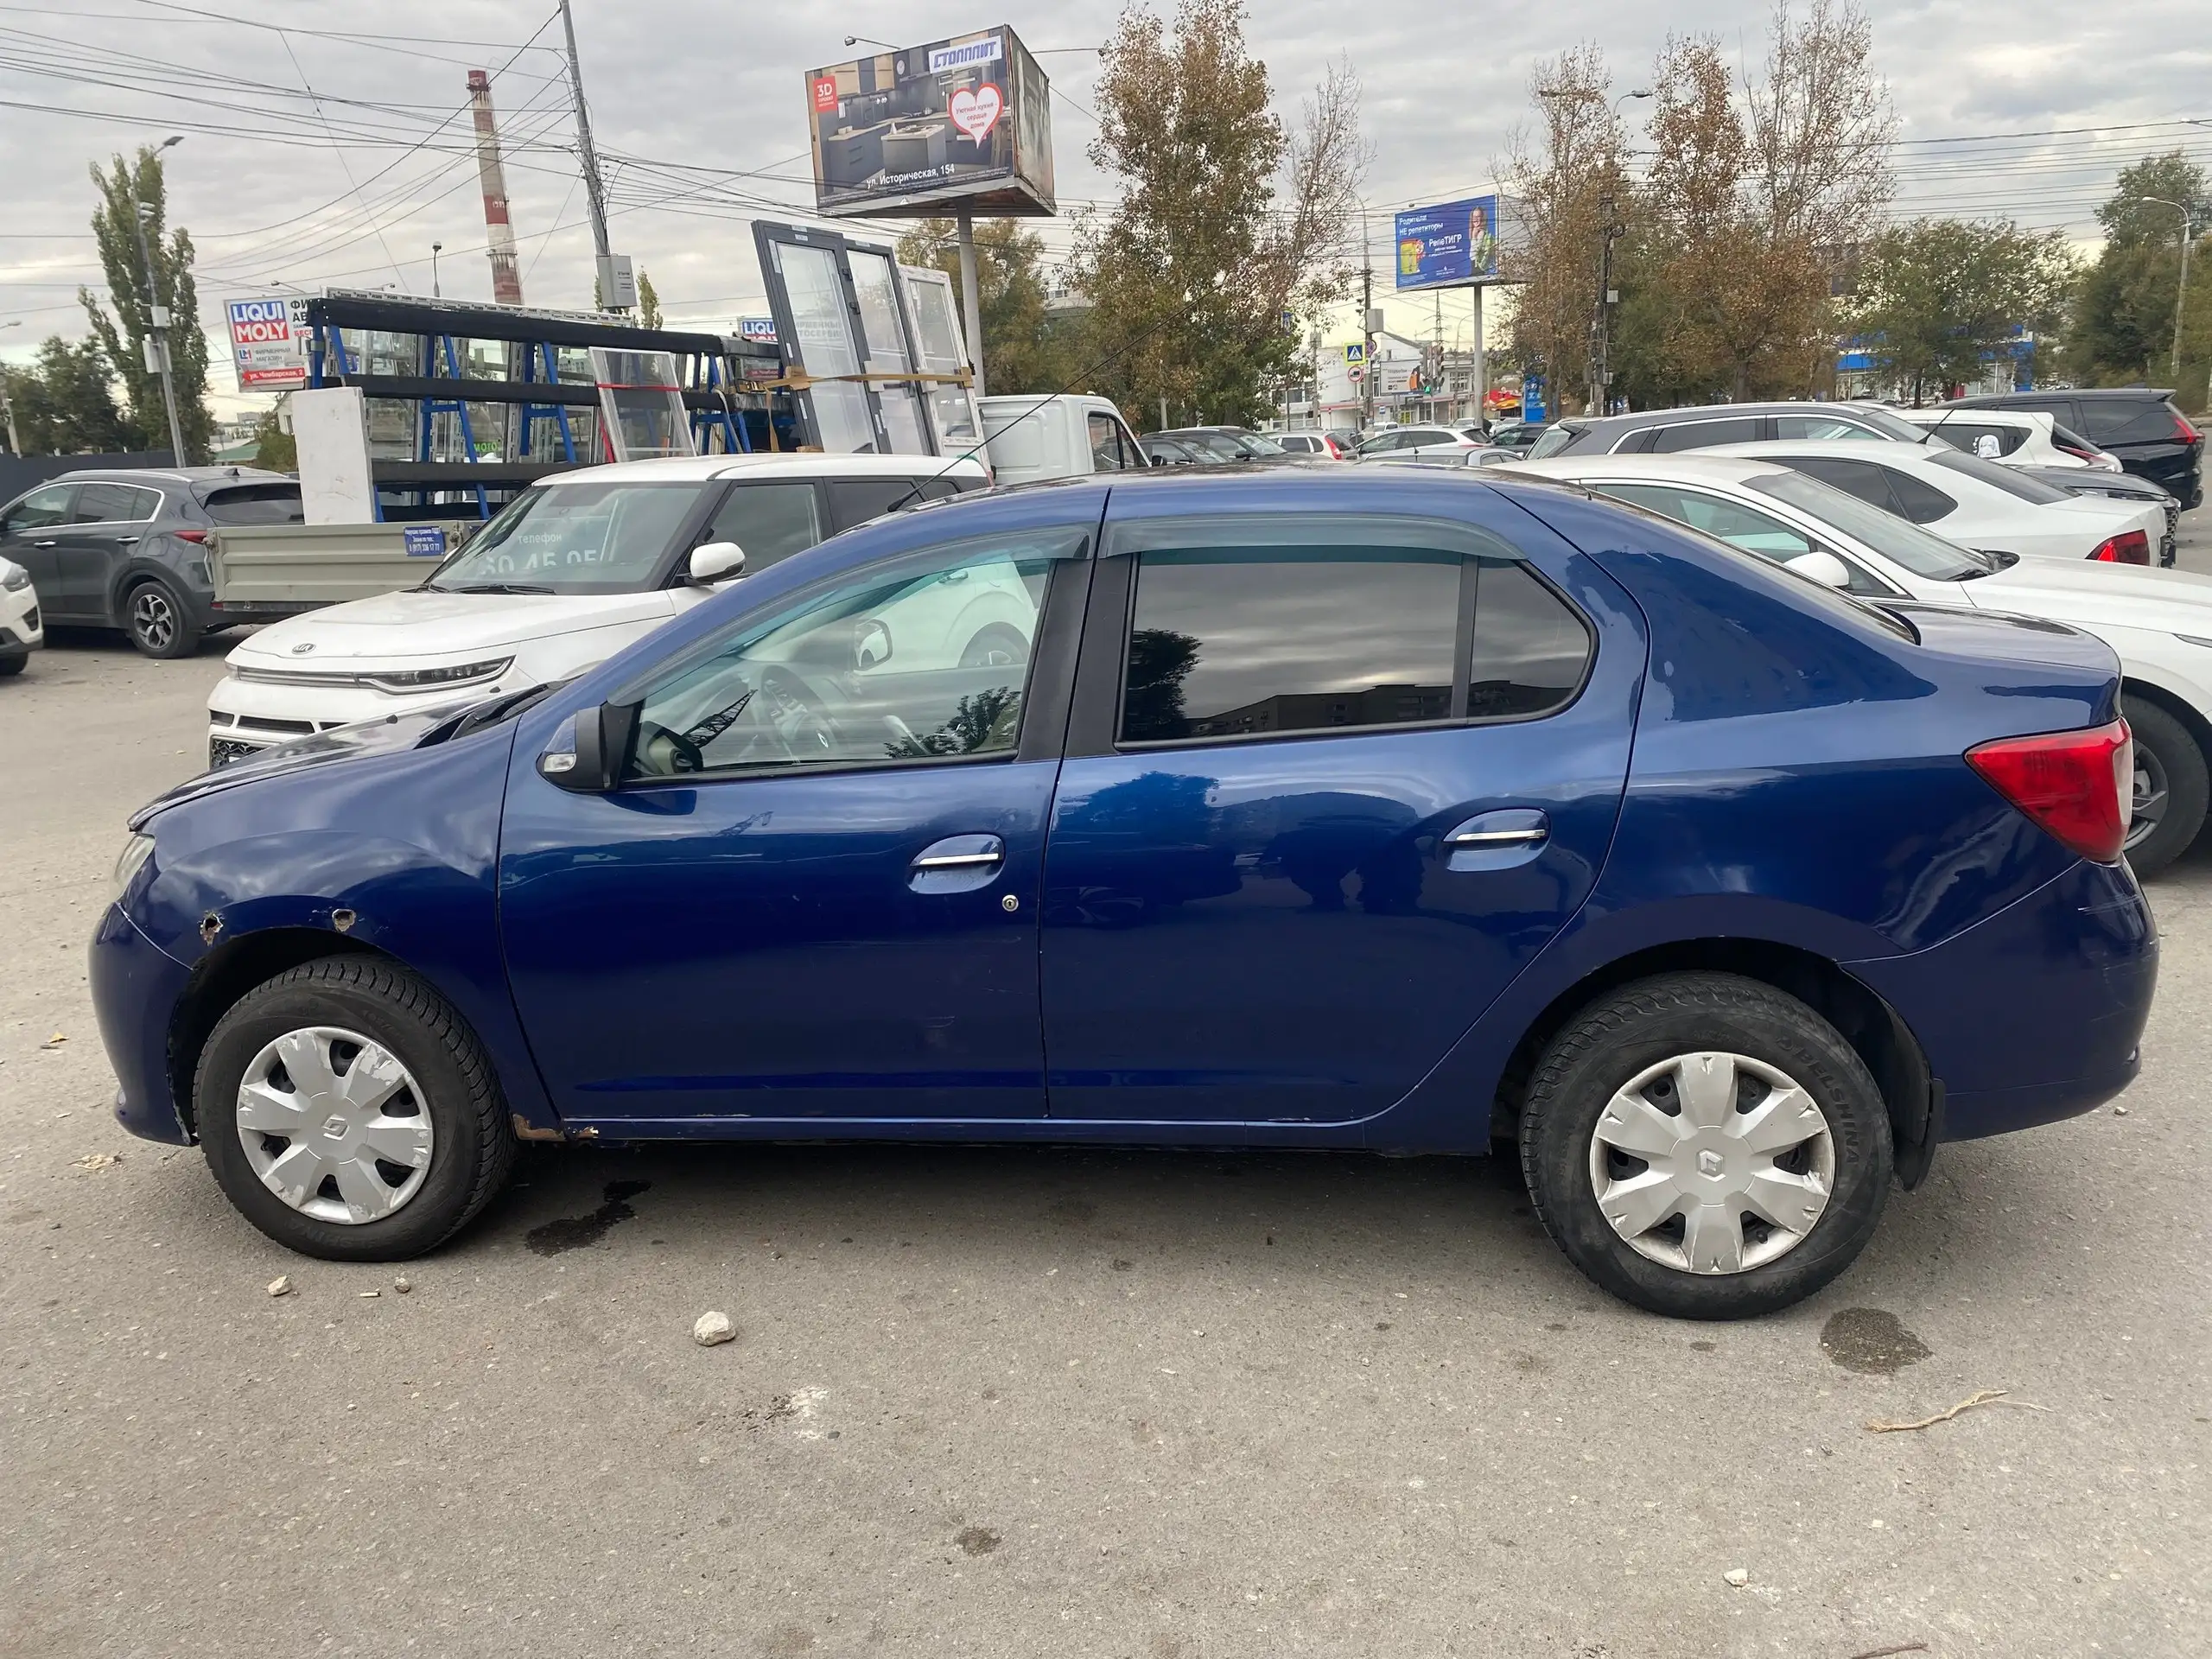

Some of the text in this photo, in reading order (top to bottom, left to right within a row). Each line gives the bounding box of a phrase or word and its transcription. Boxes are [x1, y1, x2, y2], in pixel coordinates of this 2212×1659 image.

[867, 179, 878, 189] ул.
[880, 168, 939, 185] Историческая,
[940, 163, 955, 175] 154
[232, 302, 283, 322] LIQUI
[235, 321, 286, 342] MOLY
[518, 531, 562, 545] телефон
